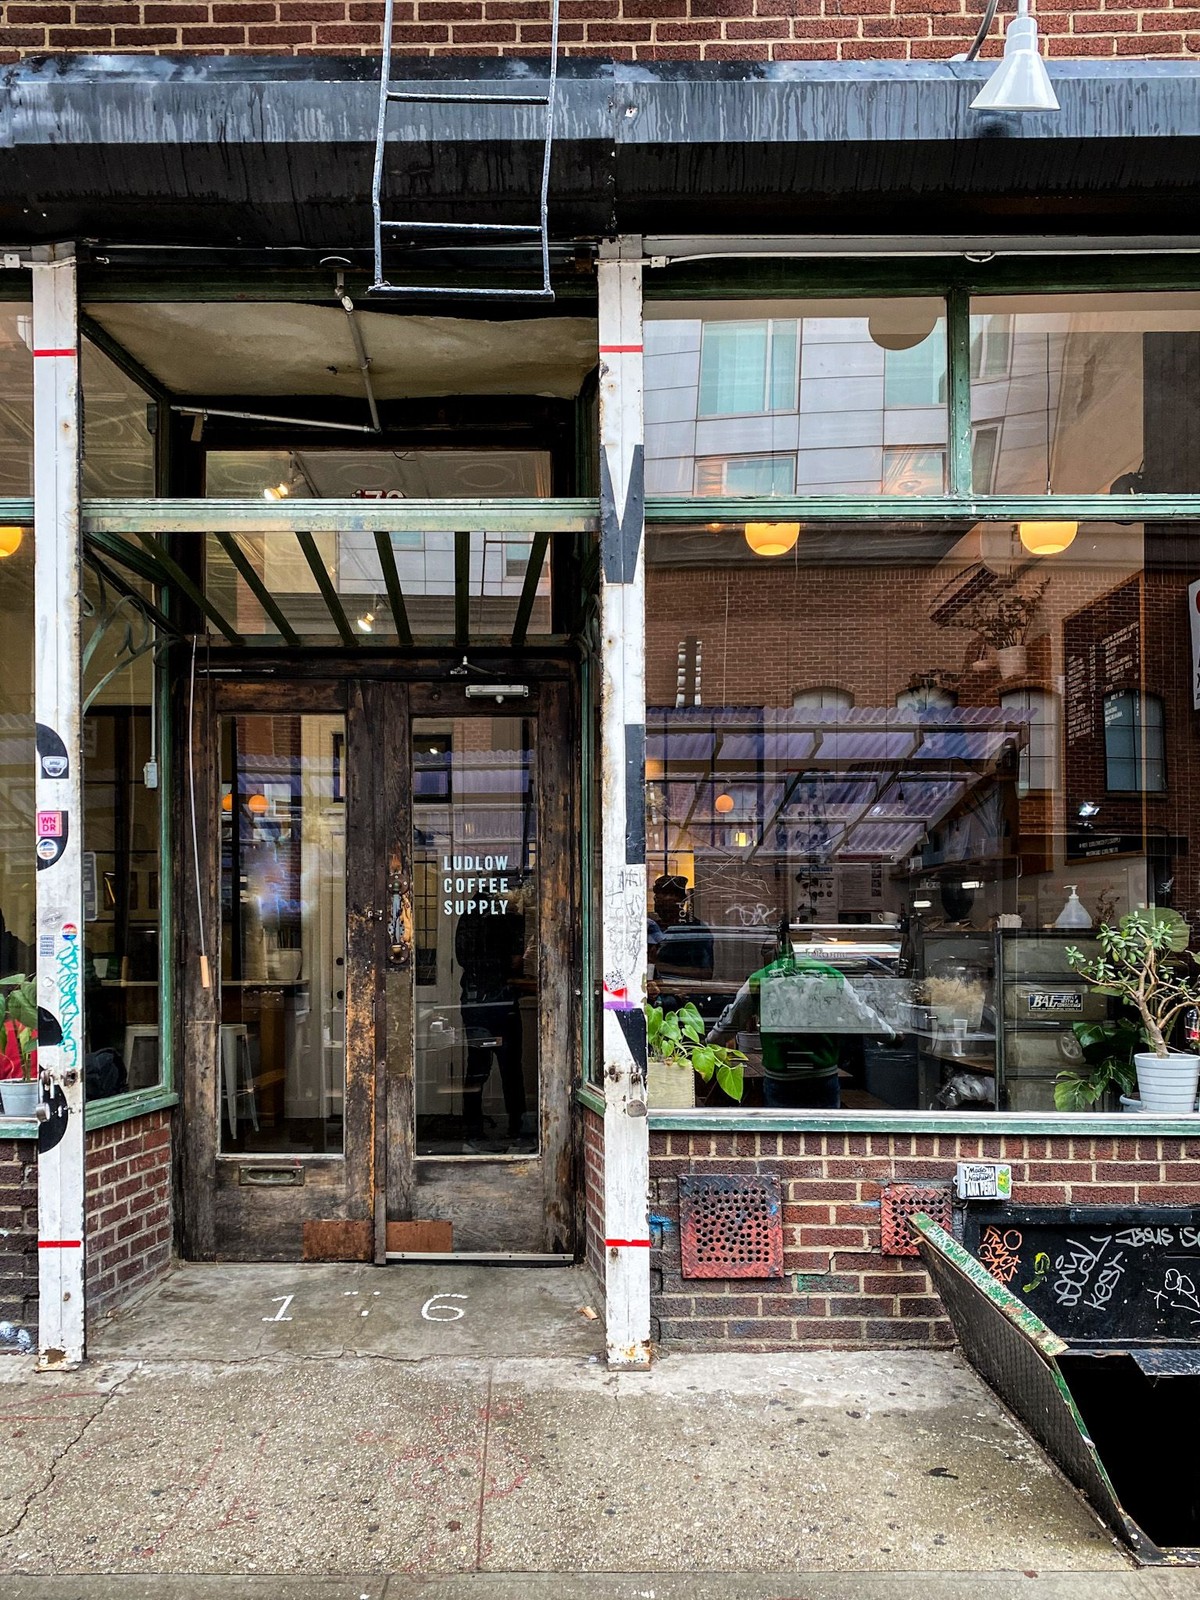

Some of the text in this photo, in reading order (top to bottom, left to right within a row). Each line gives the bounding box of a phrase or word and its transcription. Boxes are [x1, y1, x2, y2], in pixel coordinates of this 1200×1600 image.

[41, 816, 56, 824] WN
[42, 824, 56, 832] DR
[443, 855, 508, 871] LUDLOW
[443, 877, 509, 893] COFFEE
[443, 900, 508, 915] SUPPLY
[1030, 995, 1058, 1008] BAL
